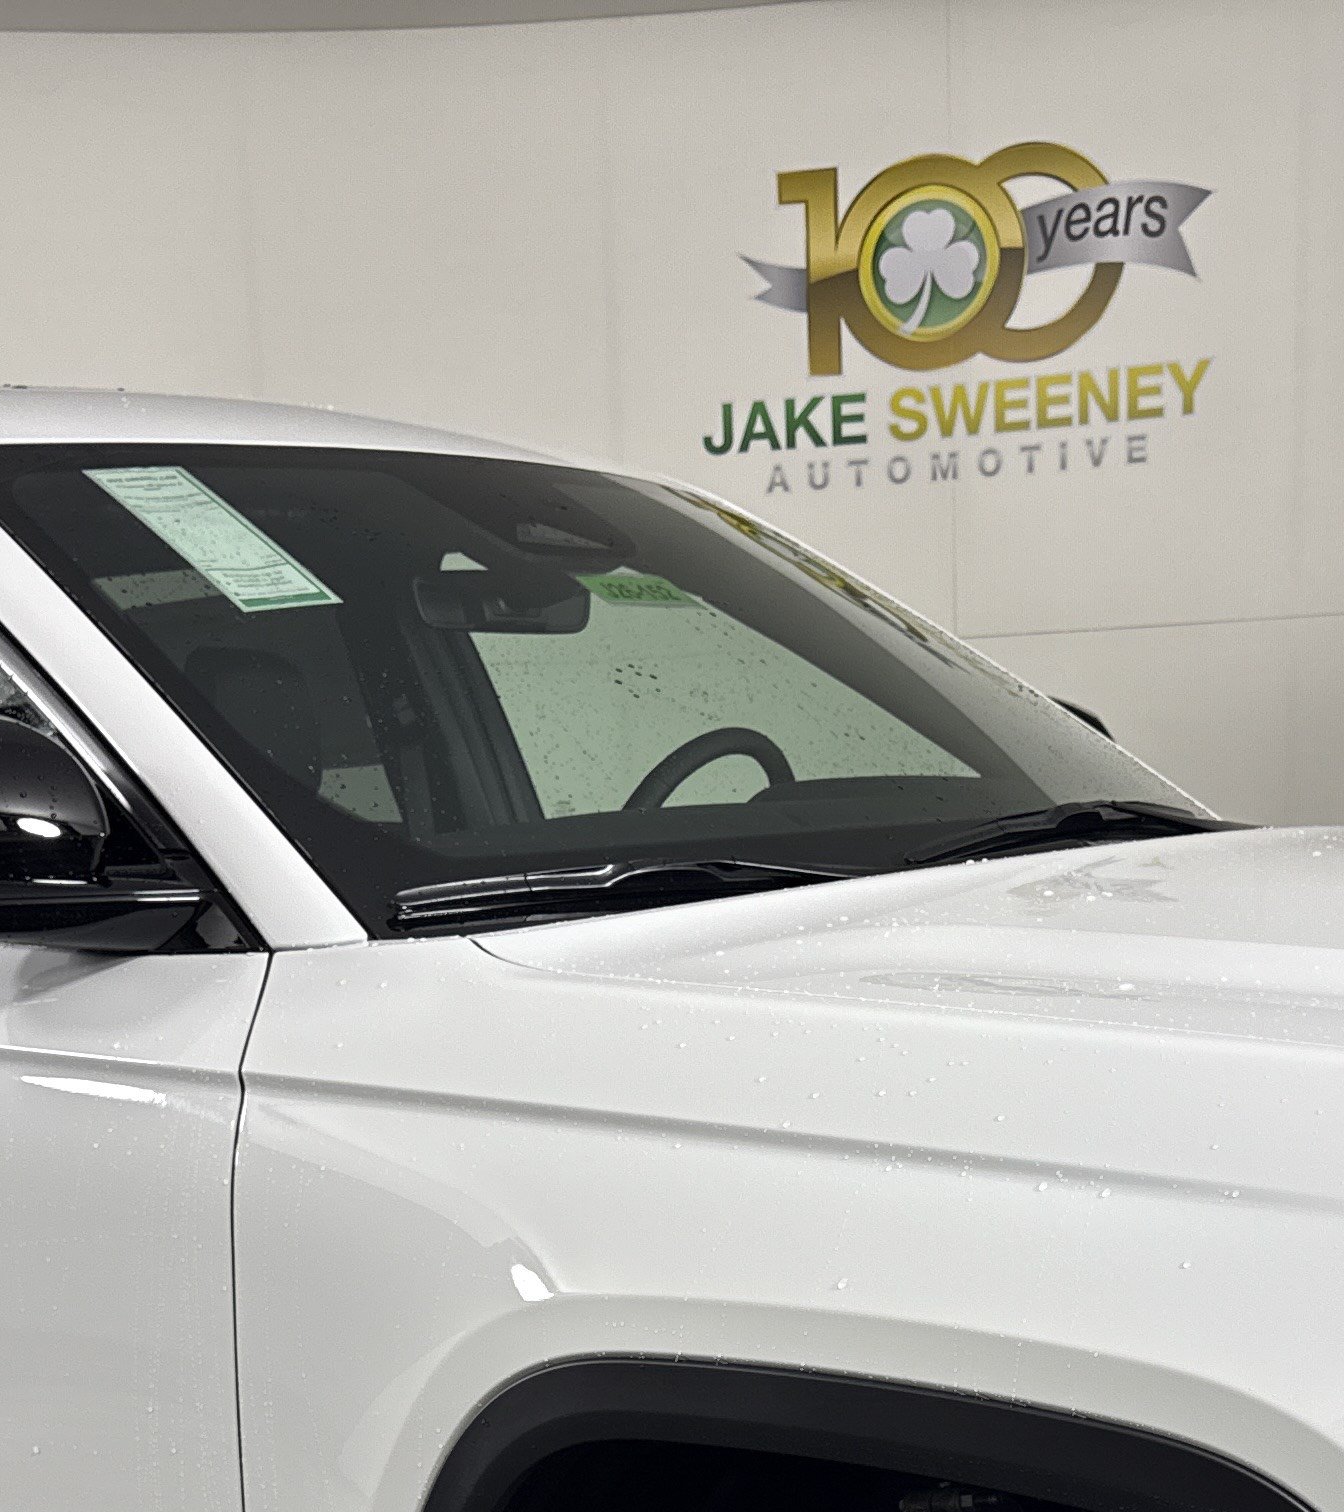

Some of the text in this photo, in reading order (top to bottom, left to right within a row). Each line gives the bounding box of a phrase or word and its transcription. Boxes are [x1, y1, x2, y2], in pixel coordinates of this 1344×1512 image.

[777, 141, 1169, 376] 100 years
[702, 358, 1213, 456] JAKE SWEENEY
[765, 433, 1149, 494] AUTOMOTIVE
